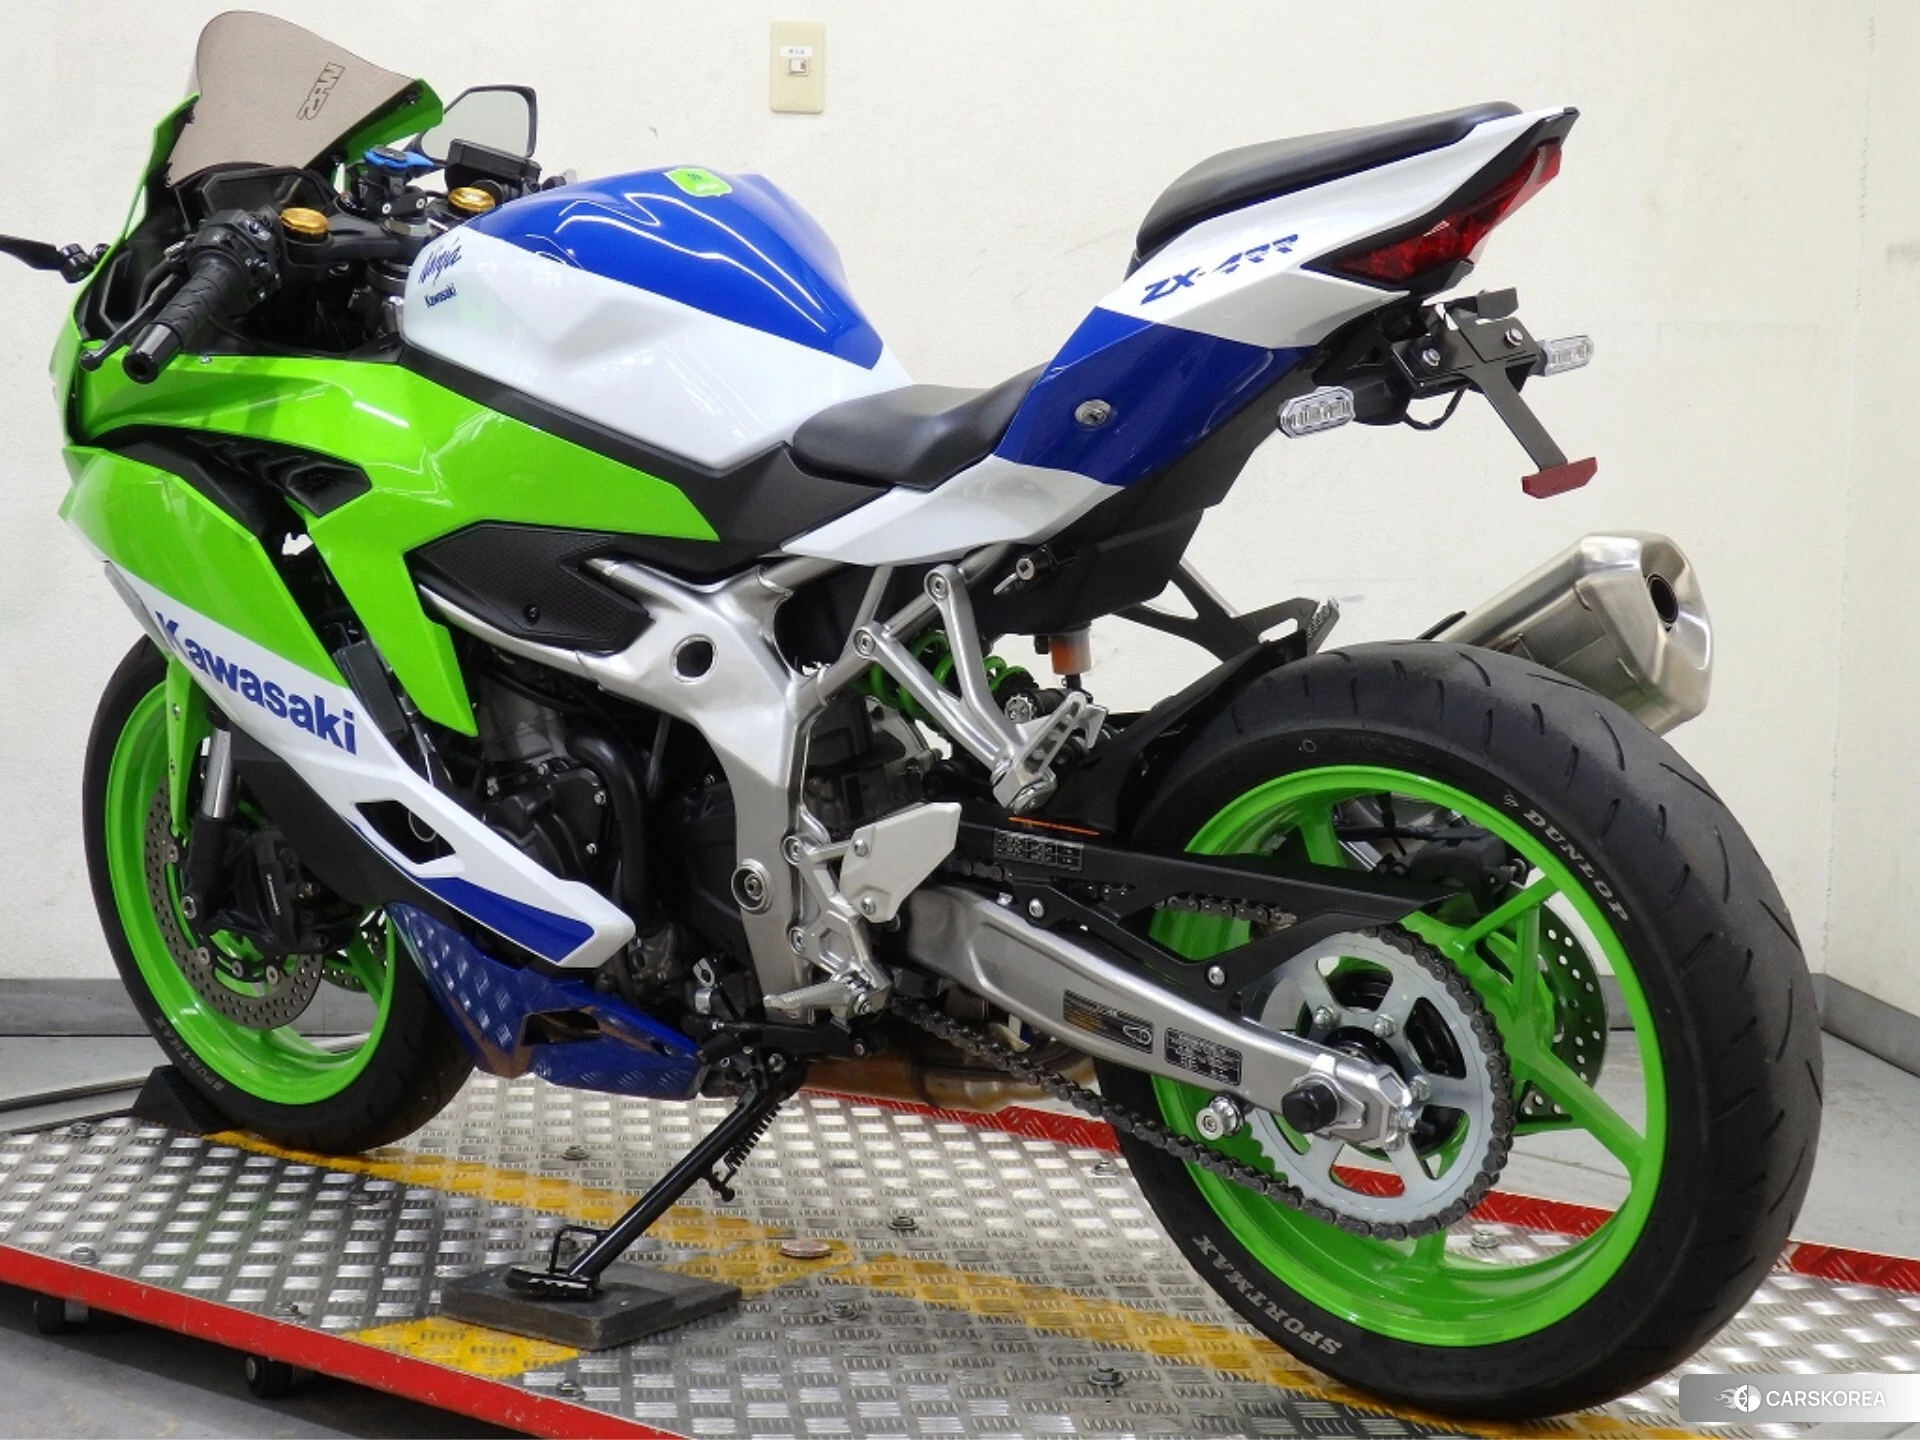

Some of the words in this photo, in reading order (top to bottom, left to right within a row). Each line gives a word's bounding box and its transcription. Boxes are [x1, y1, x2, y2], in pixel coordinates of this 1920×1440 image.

[417, 236, 462, 287] Ninja
[424, 283, 457, 308] Kawasaki
[1523, 809, 1629, 921] DUNLOP
[1192, 1234, 1344, 1355] SPORTMAX
